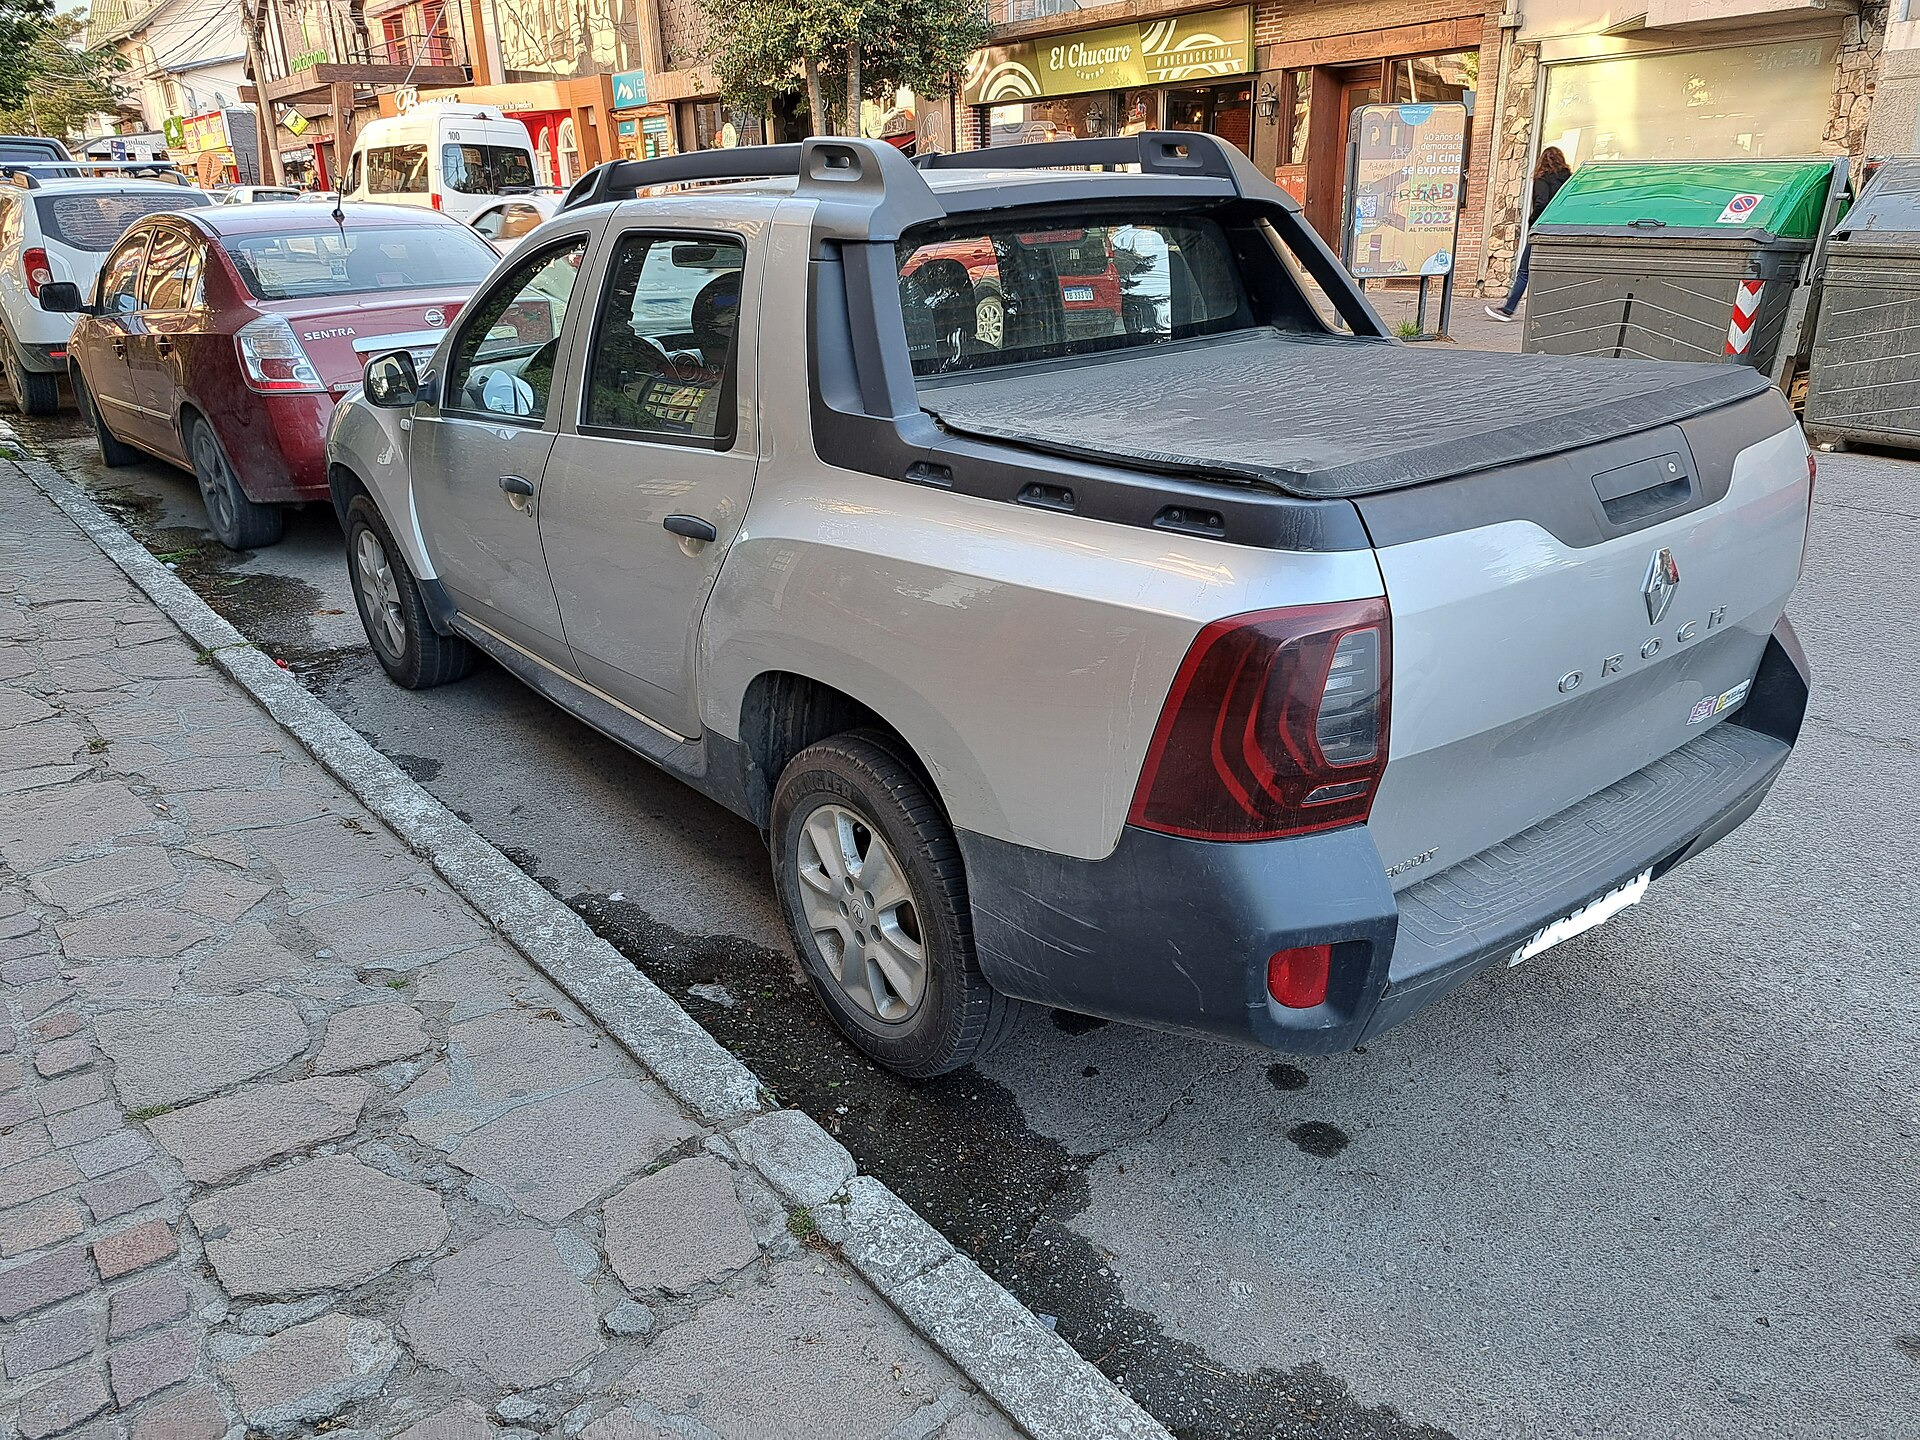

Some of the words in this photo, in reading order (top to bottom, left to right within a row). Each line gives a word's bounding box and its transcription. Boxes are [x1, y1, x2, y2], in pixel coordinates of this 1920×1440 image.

[1049, 45, 1065, 71] El
[1068, 42, 1132, 69] Chucaro
[1076, 67, 1105, 81] CENTRO
[447, 131, 461, 141] 100
[1423, 132, 1434, 141] 40
[1435, 132, 1453, 141] años
[1454, 132, 1463, 141] de
[1420, 142, 1462, 150] democracia
[1426, 152, 1436, 163] el
[1438, 151, 1461, 163] cine
[1401, 165, 1414, 175] se
[1416, 165, 1460, 177] expresa
[1413, 211, 1451, 224] 2023
[304, 327, 356, 341] SENTRA
[1558, 604, 1727, 693] OROCH
[1384, 846, 1440, 879] ENAULT
